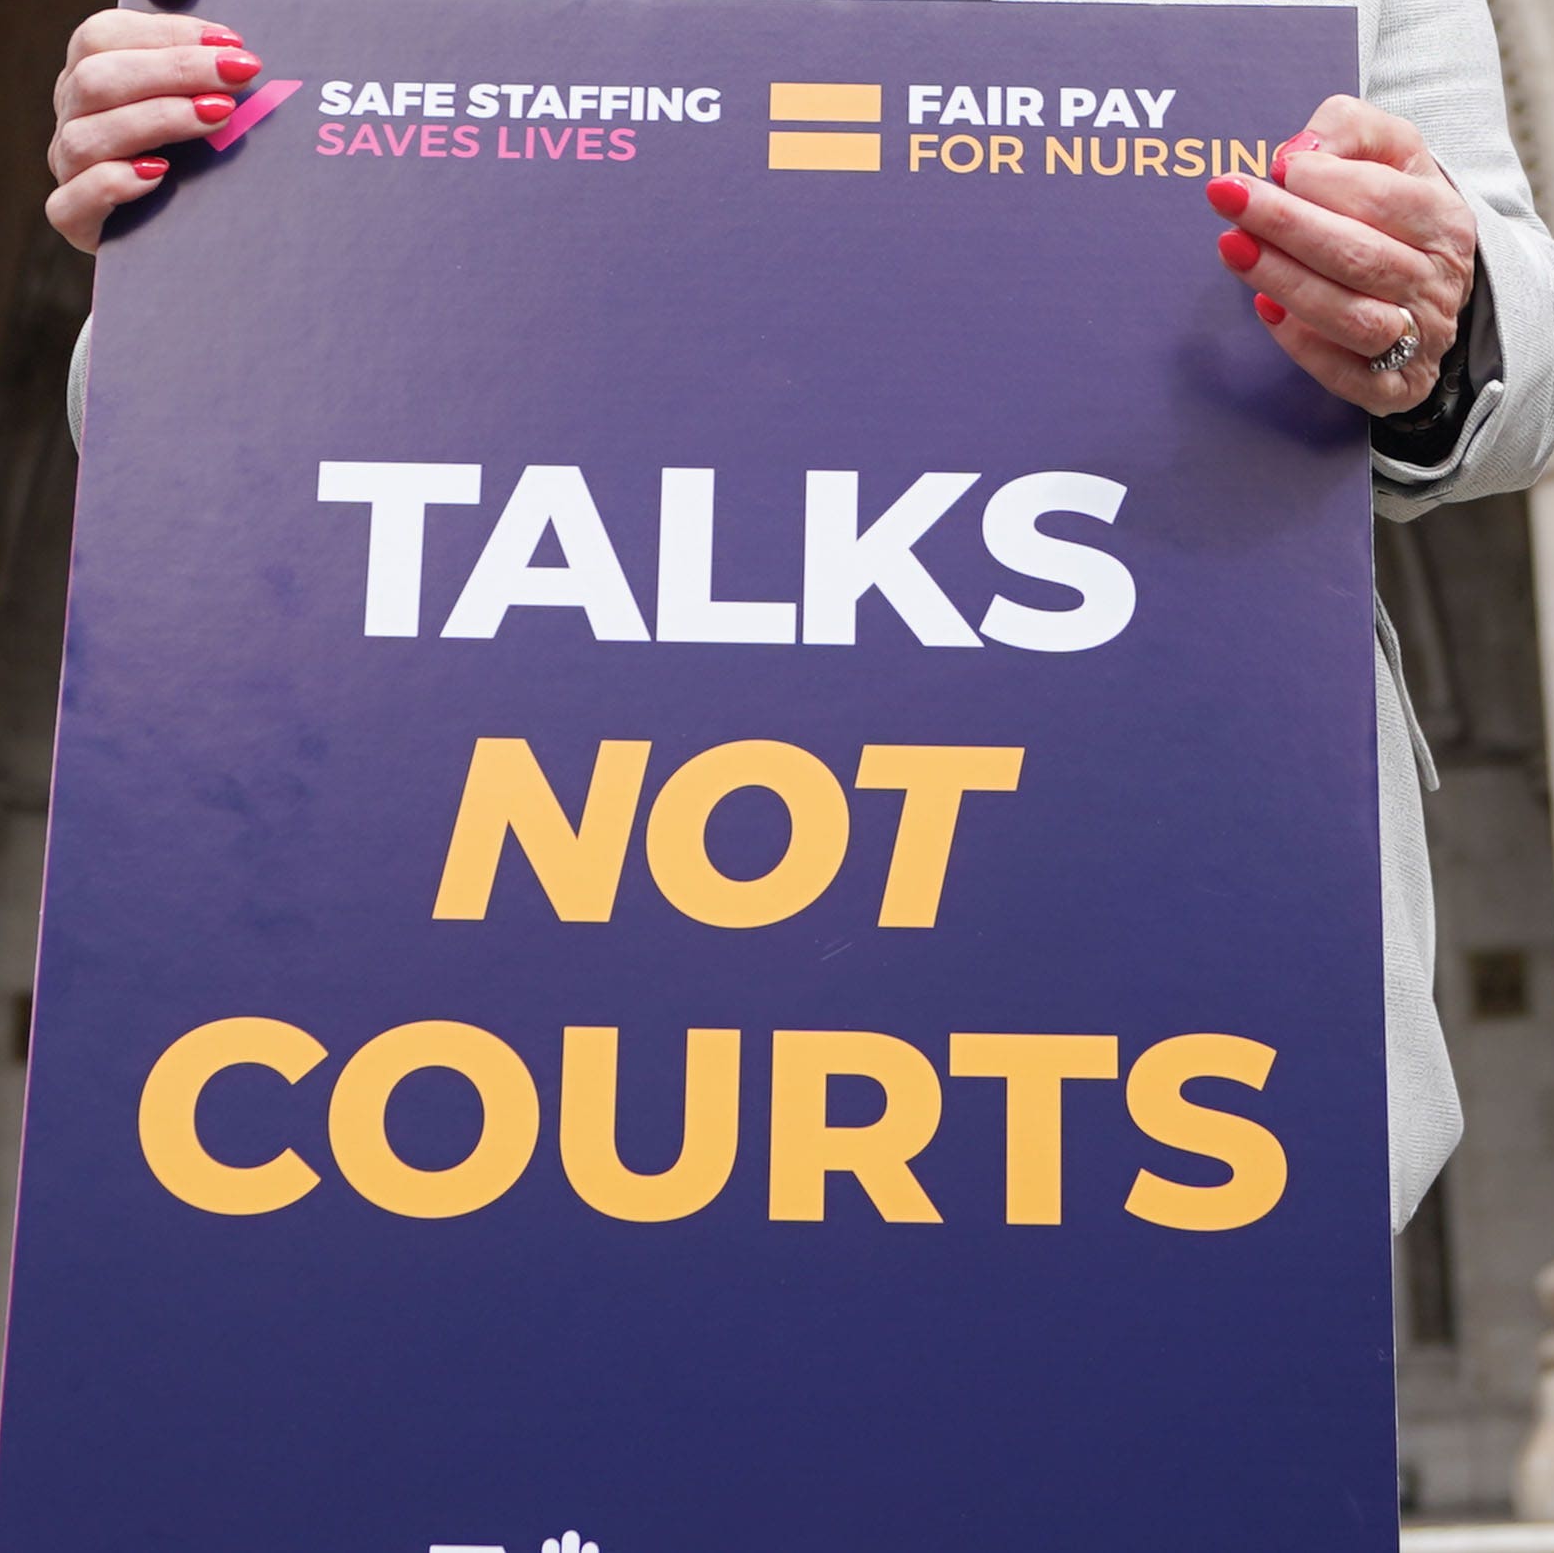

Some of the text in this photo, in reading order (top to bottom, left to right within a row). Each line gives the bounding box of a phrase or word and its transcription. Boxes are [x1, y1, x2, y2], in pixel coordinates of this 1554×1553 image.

[318, 80, 721, 123] SAFE STAFFING
[908, 85, 1176, 129] FAIR PAY
[315, 122, 636, 161] SAVES LIVES
[909, 133, 1289, 177] FOR NURSIN
[316, 460, 1137, 653] TALKS
[431, 737, 1025, 929] NOT
[138, 1016, 1288, 1232] COURTS
